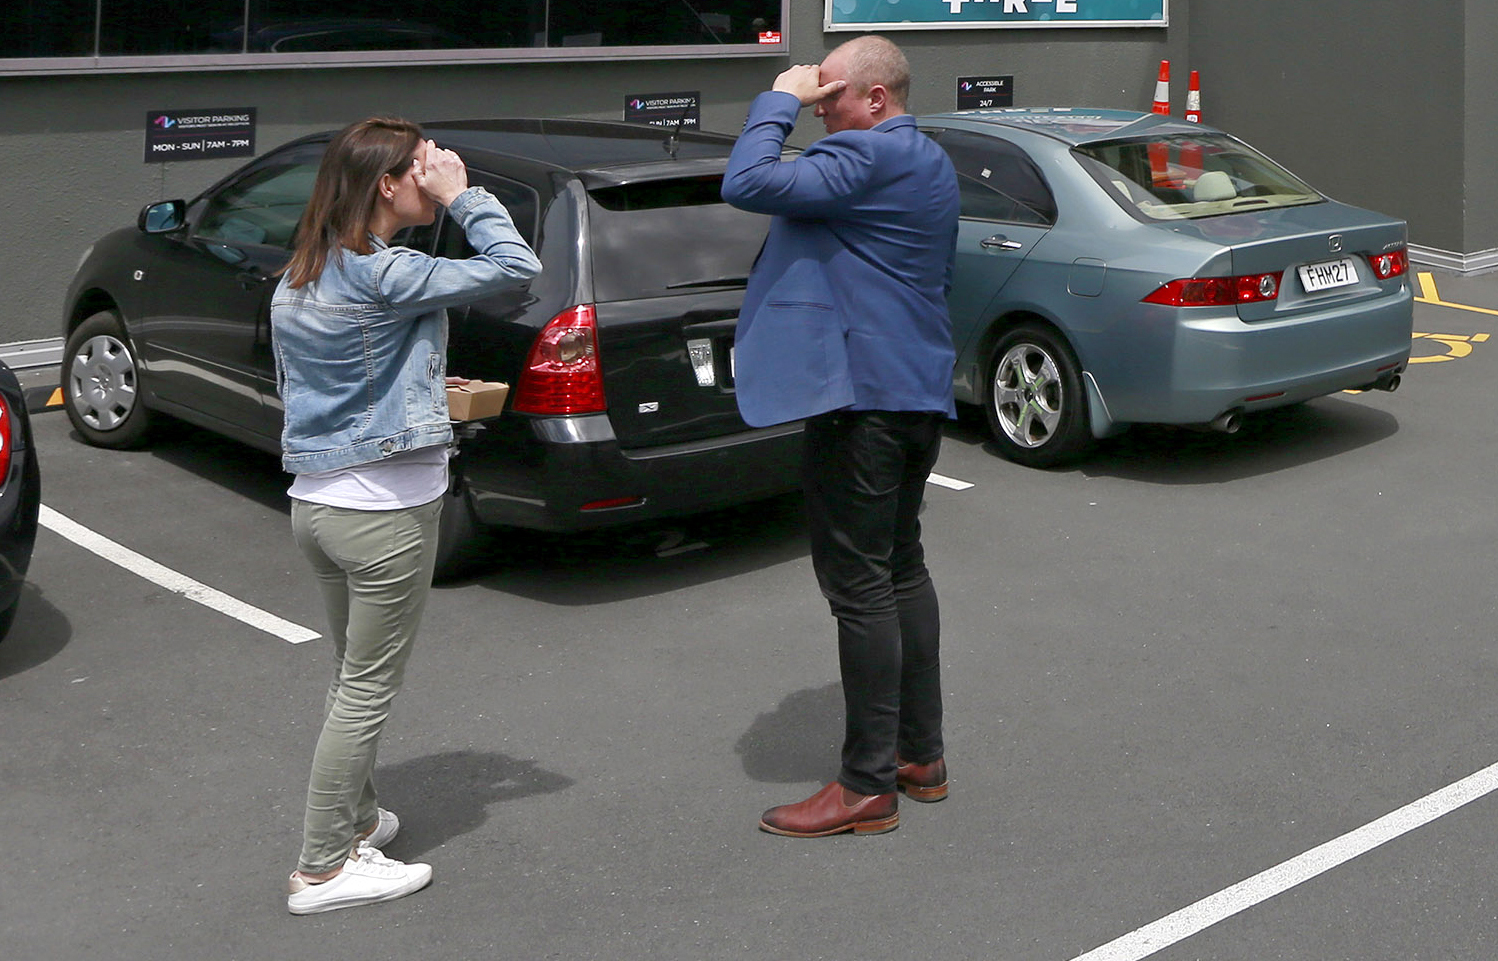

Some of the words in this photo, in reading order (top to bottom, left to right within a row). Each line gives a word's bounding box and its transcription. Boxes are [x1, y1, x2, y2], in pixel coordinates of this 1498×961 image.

[177, 116, 211, 125] VISITOR
[212, 115, 250, 124] PARKING
[153, 144, 175, 152] MON
[182, 142, 201, 150] SUN
[206, 140, 226, 148] 7AM
[231, 139, 249, 147] 7PM
[1307, 262, 1349, 287] FHM27
